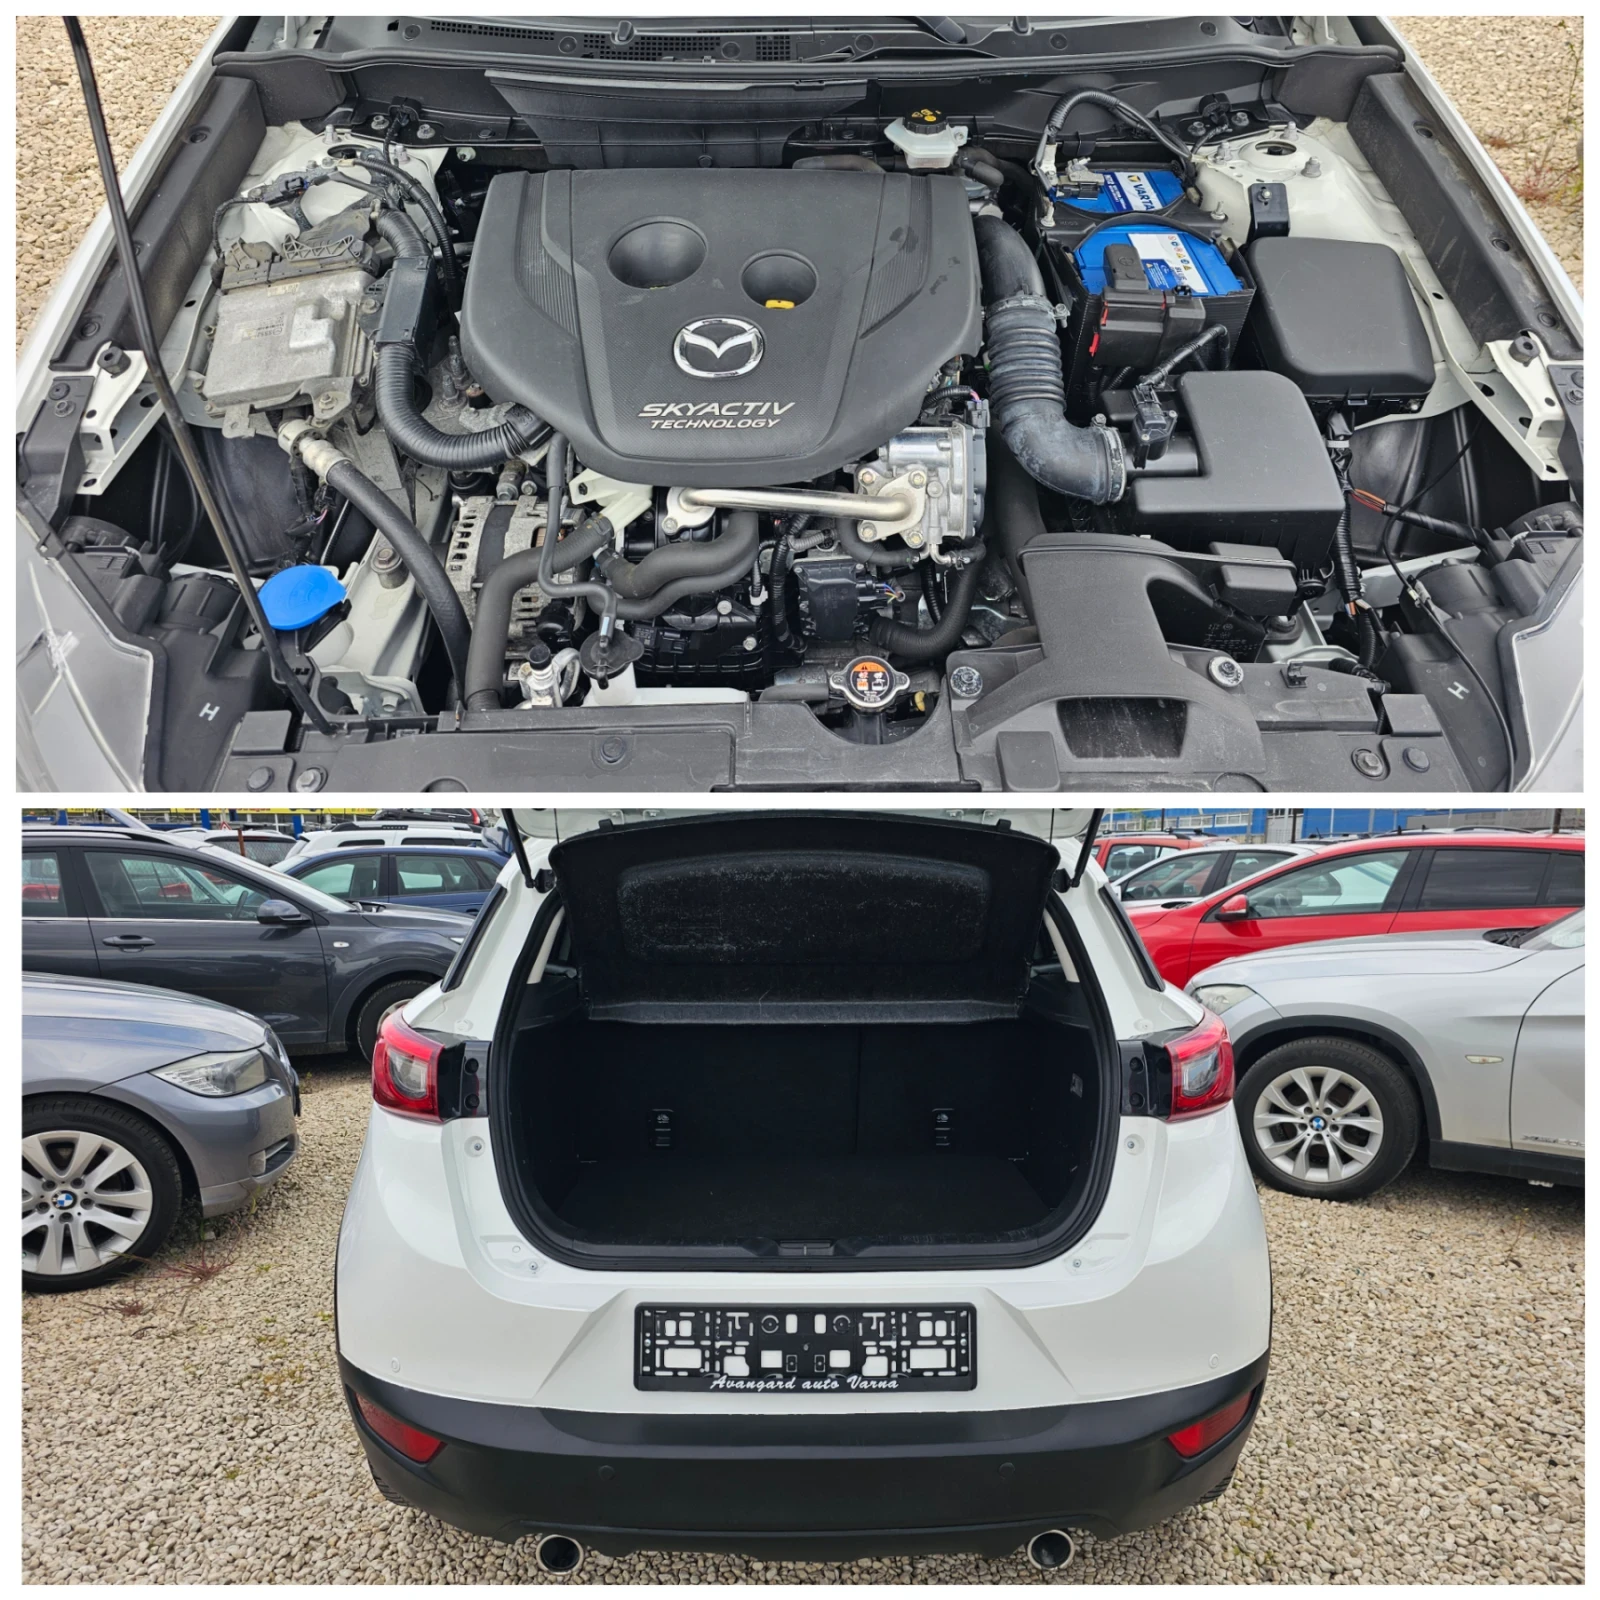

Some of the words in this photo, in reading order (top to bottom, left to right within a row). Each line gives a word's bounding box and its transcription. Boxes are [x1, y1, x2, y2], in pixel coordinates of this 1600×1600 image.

[1133, 184, 1155, 211] VARTA
[638, 402, 796, 417] SKYACTIV
[650, 418, 781, 429] TECHNOLOGY
[198, 702, 220, 721] H
[709, 1374, 796, 1392] Avangard
[801, 1375, 840, 1390] auto
[846, 1374, 900, 1390] Varna
